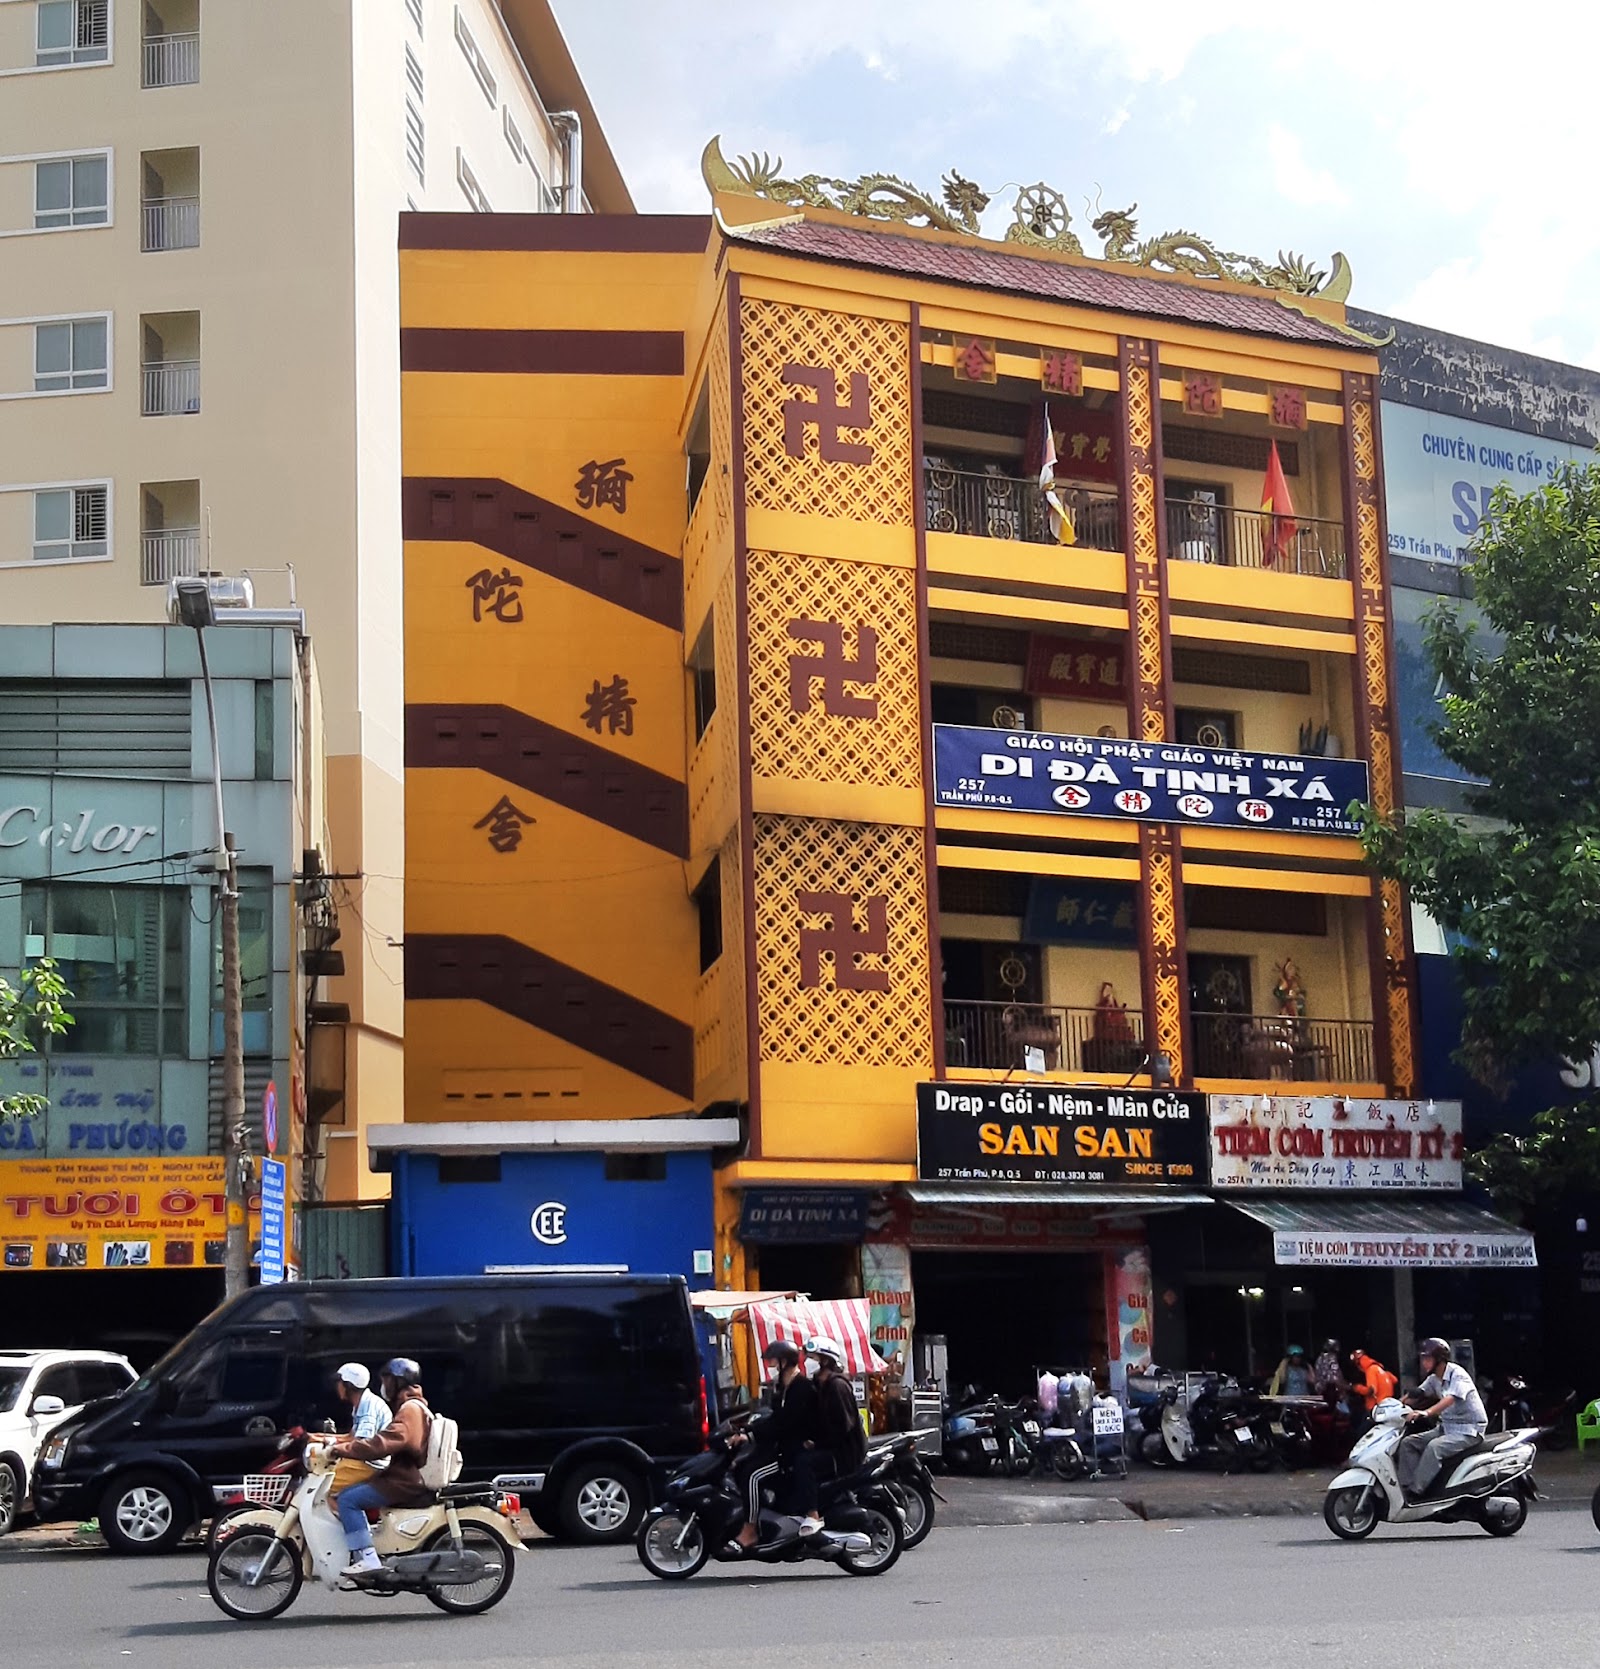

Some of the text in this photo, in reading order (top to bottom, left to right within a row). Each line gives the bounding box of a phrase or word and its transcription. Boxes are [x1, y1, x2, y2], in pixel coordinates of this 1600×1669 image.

[1422, 433, 1475, 463] CHUYÊN
[1479, 446, 1514, 471] CUNG
[1517, 449, 1542, 477] CẤP
[1387, 533, 1406, 550] 259
[1006, 734, 1304, 773] GIÁO HỘI PHẬT GIÁO VIỆT NAM
[958, 778, 986, 791] 257
[981, 753, 1334, 802] DI ĐÀ TỊNH XÁ
[1316, 806, 1341, 819] 257
[935, 1090, 984, 1116] Drap
[1000, 1088, 1033, 1115] Gối
[1050, 1094, 1093, 1120] Nệm
[1108, 1095, 1148, 1118] Màn
[1152, 1092, 1190, 1119] Cửa
[979, 1123, 1153, 1158] SAN SAN
[938, 1167, 953, 1177] 257
[1125, 1162, 1163, 1175] SINCE
